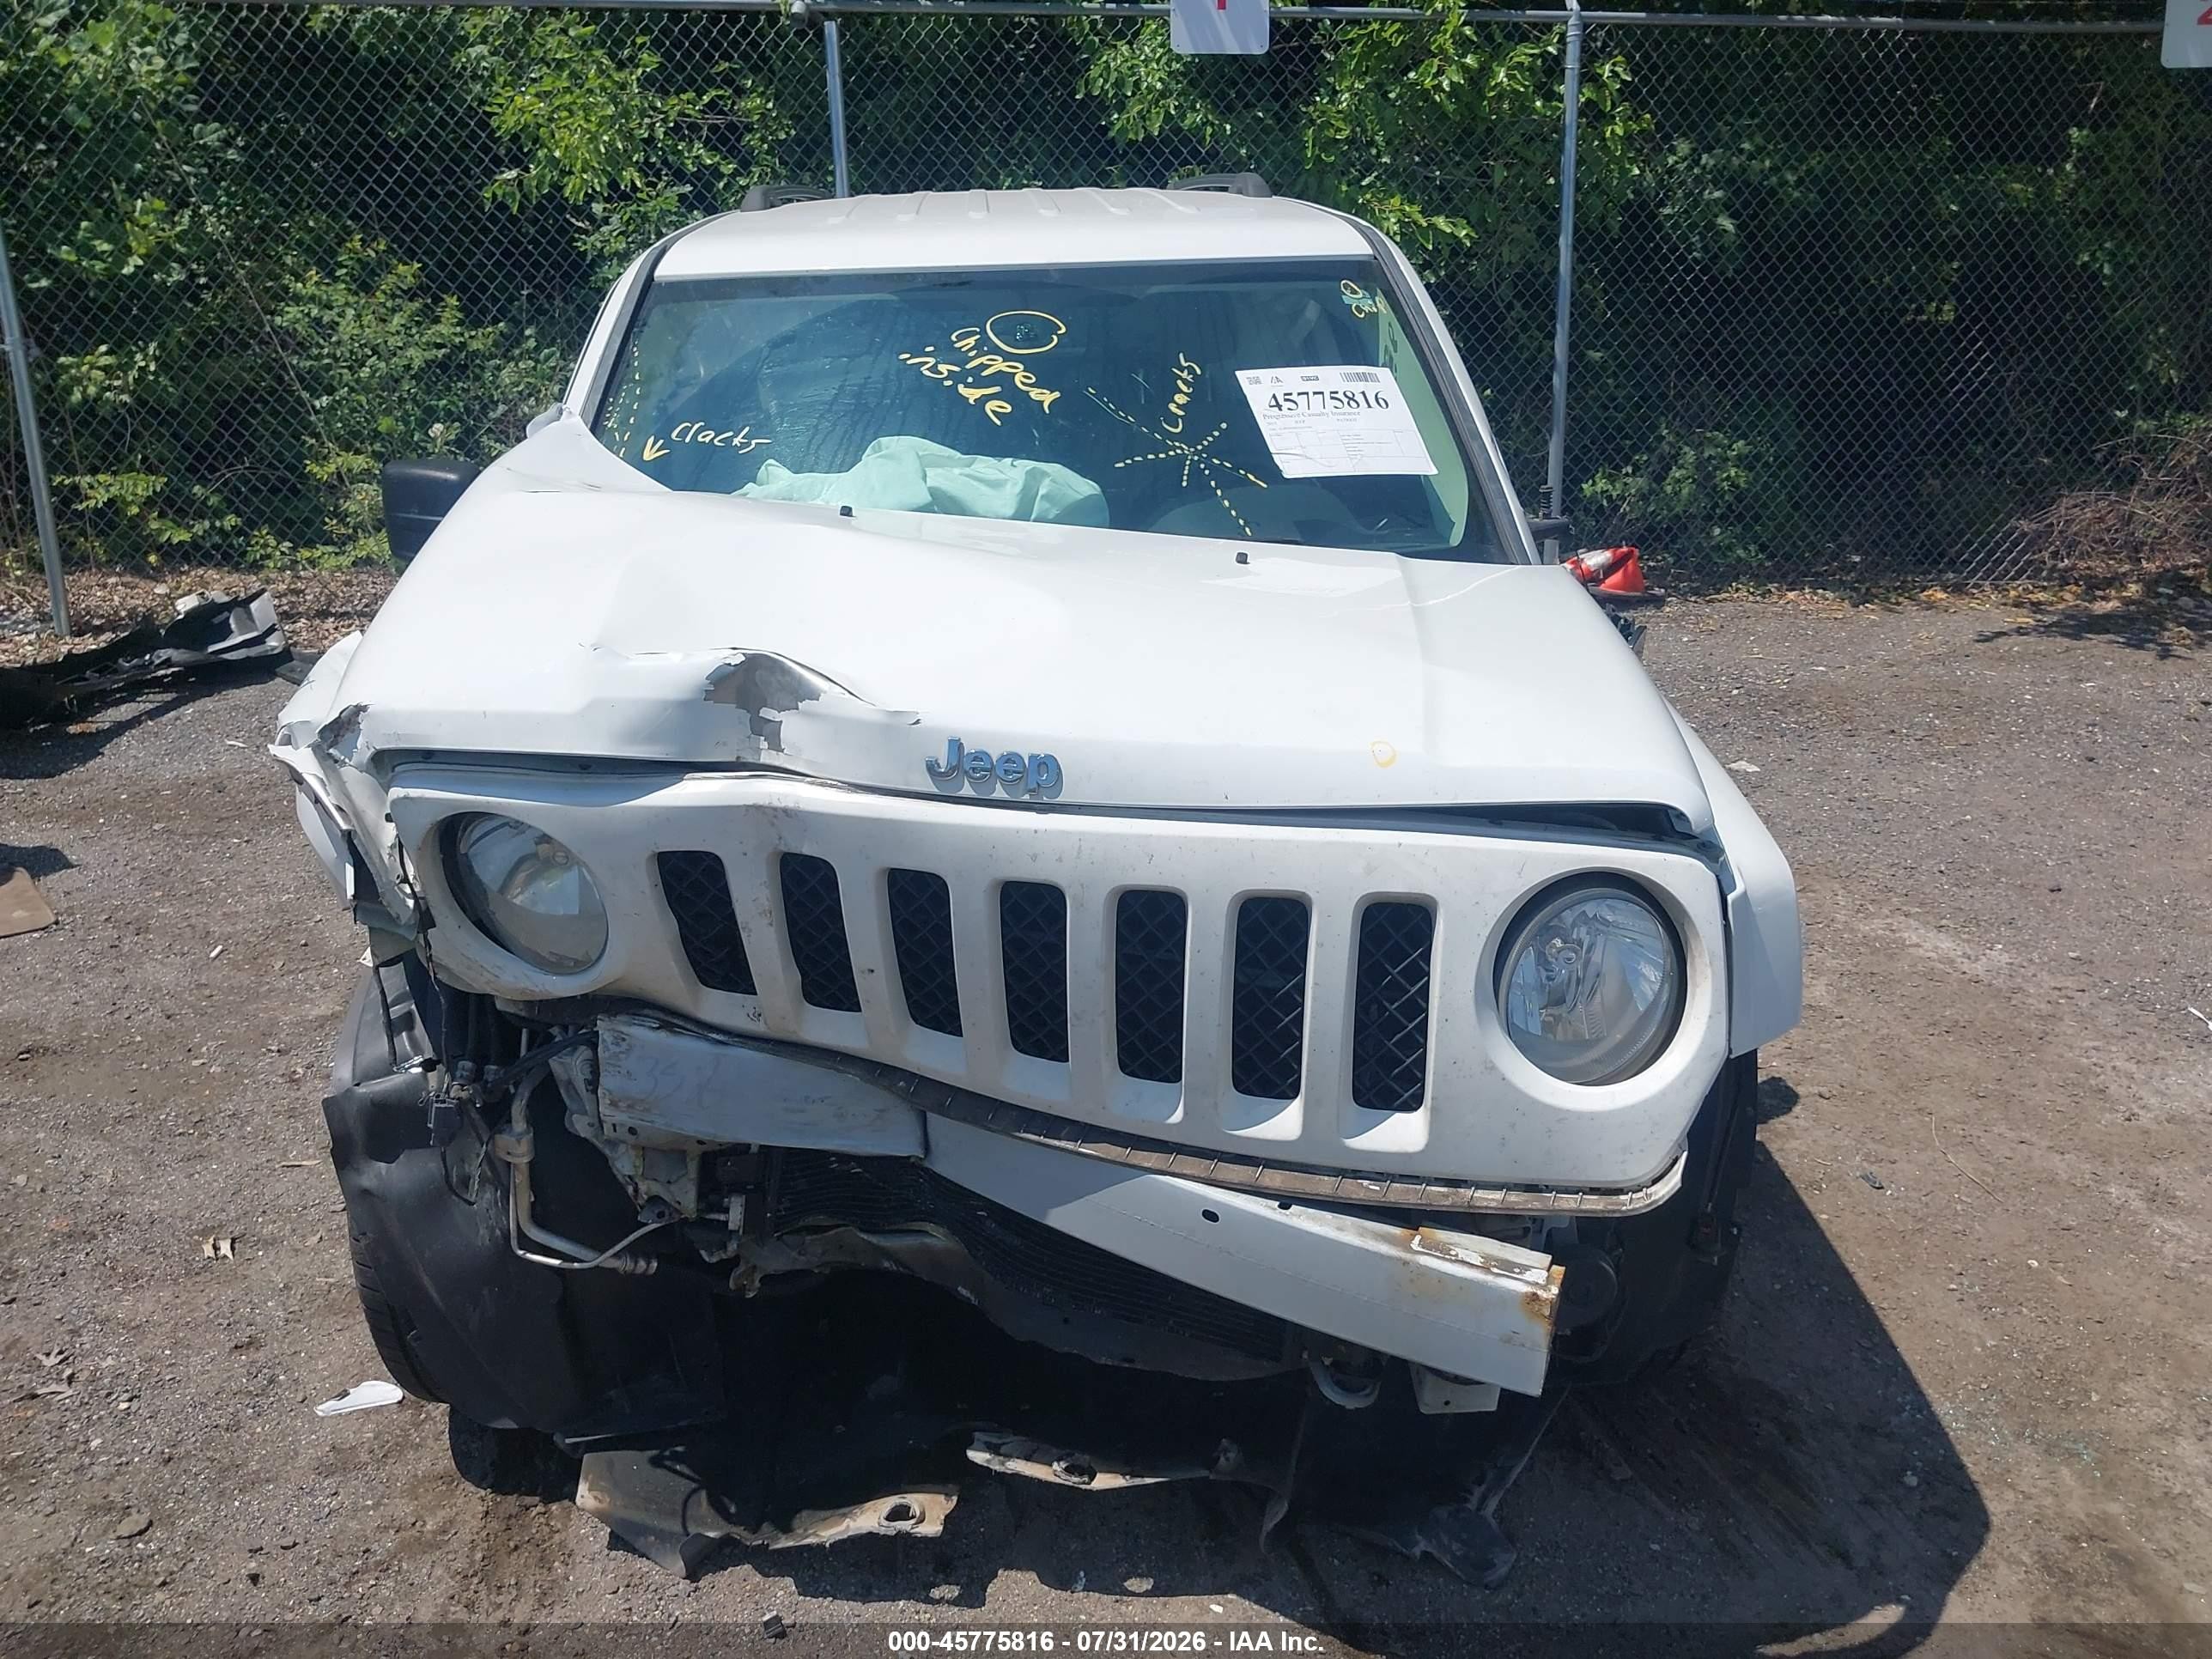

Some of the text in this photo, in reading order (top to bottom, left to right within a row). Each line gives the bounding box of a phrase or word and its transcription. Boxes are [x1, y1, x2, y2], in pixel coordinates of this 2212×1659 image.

[898, 345, 1012, 427] inside
[951, 326, 1062, 414] Chipped
[1159, 351, 1202, 434] Cracks
[1267, 389, 1390, 412] 45775816
[925, 736, 1061, 797] Jeep
